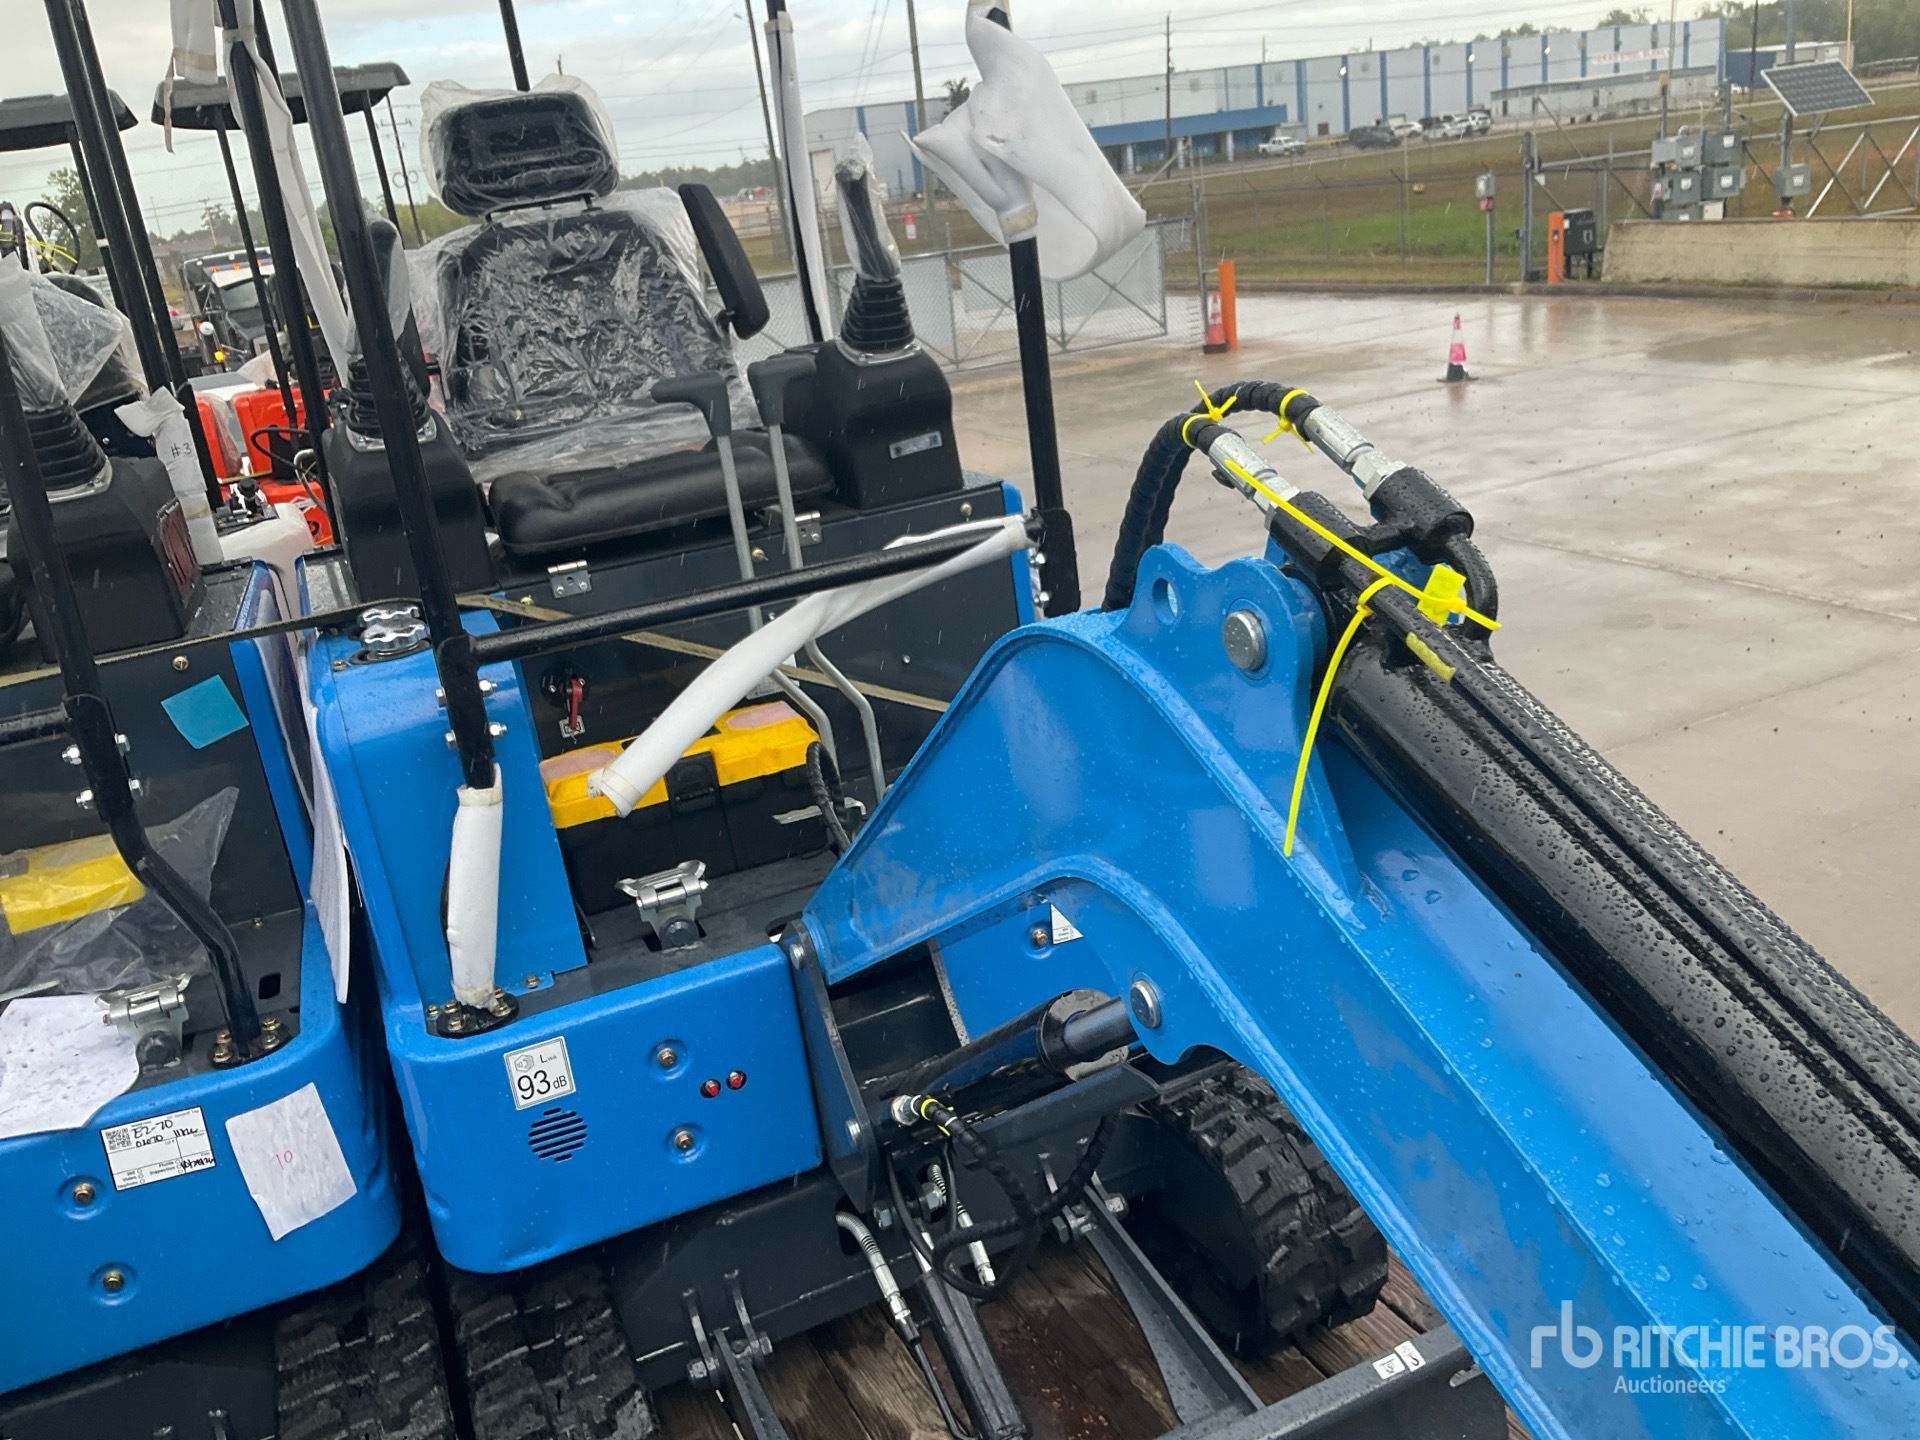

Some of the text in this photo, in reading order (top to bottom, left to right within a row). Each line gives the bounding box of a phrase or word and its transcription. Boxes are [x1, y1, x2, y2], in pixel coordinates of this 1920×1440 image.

[170, 442, 193, 459] #3
[517, 1069, 568, 1100] 93 dB
